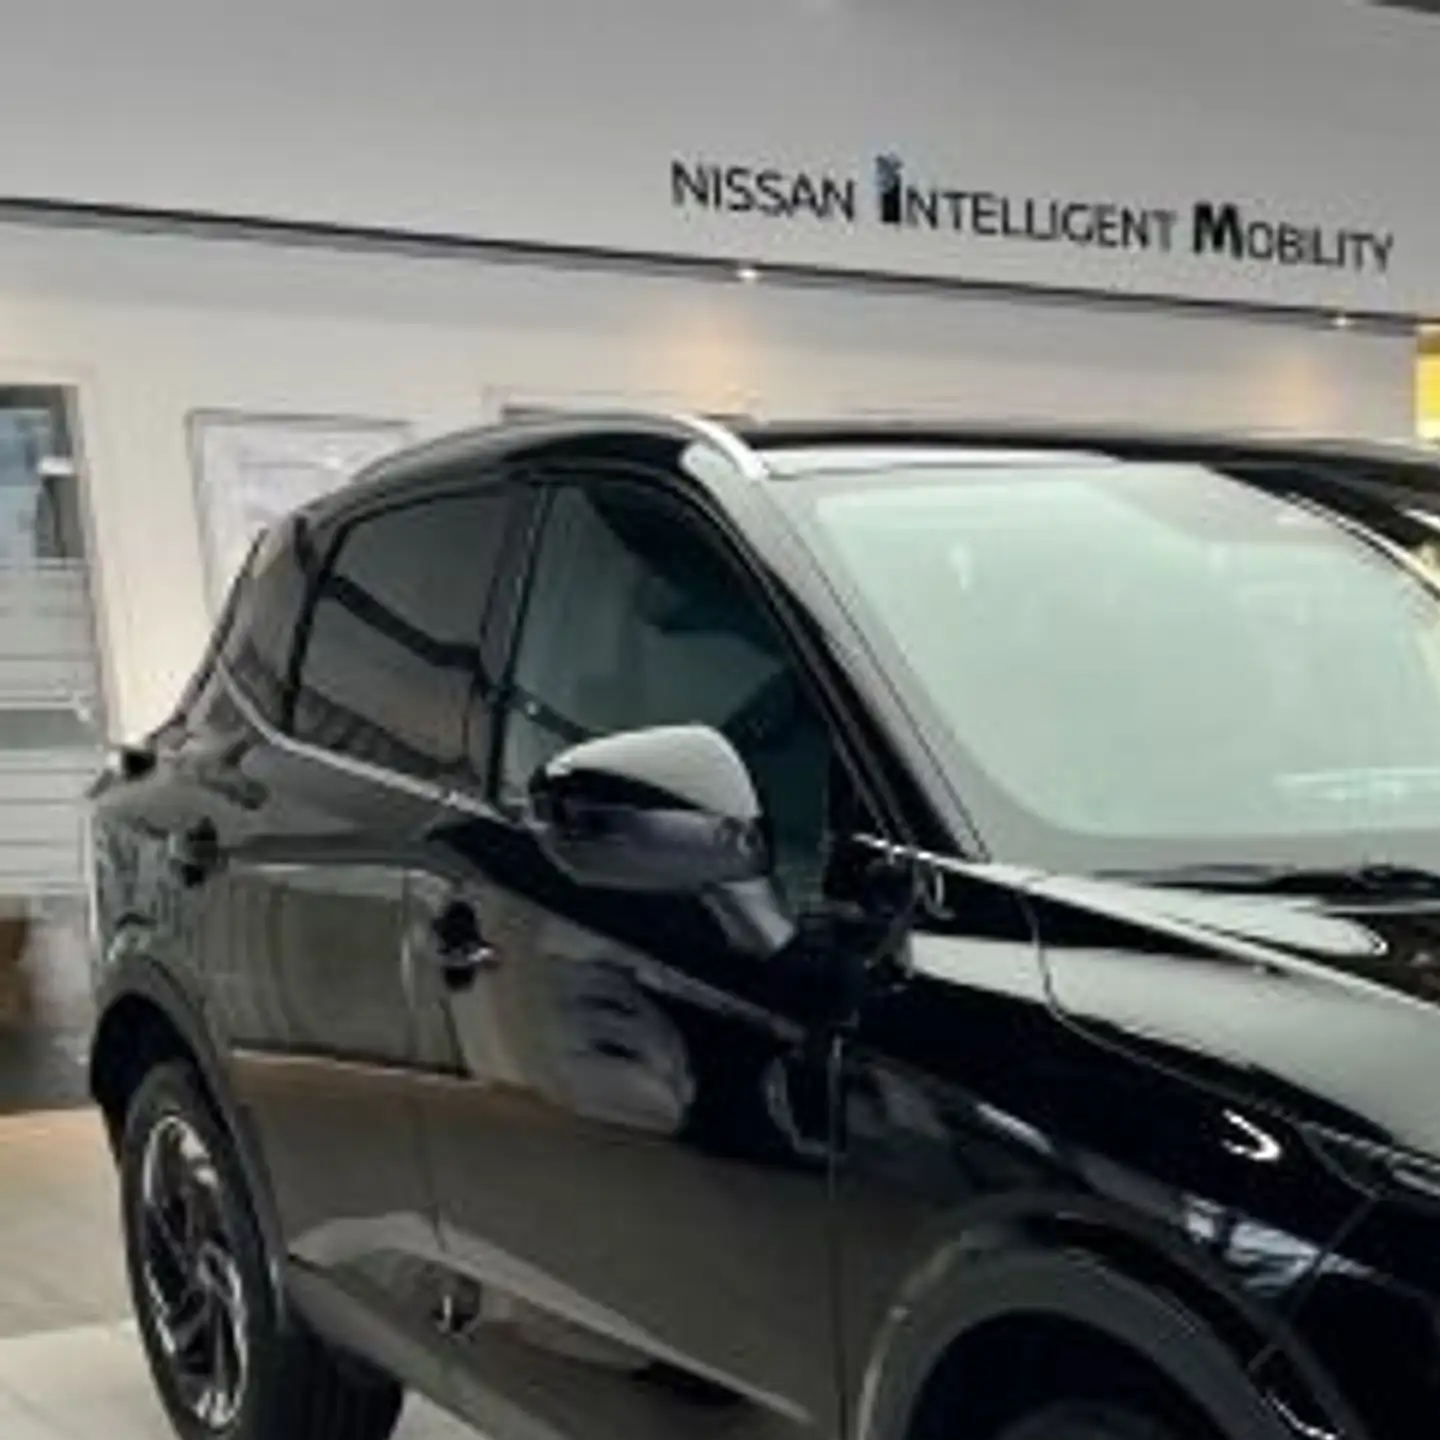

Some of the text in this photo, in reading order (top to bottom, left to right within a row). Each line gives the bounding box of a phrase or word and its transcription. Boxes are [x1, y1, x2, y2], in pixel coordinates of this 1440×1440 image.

[670, 153, 1394, 272] NISSAN INTELLIGENT MOBILITY
